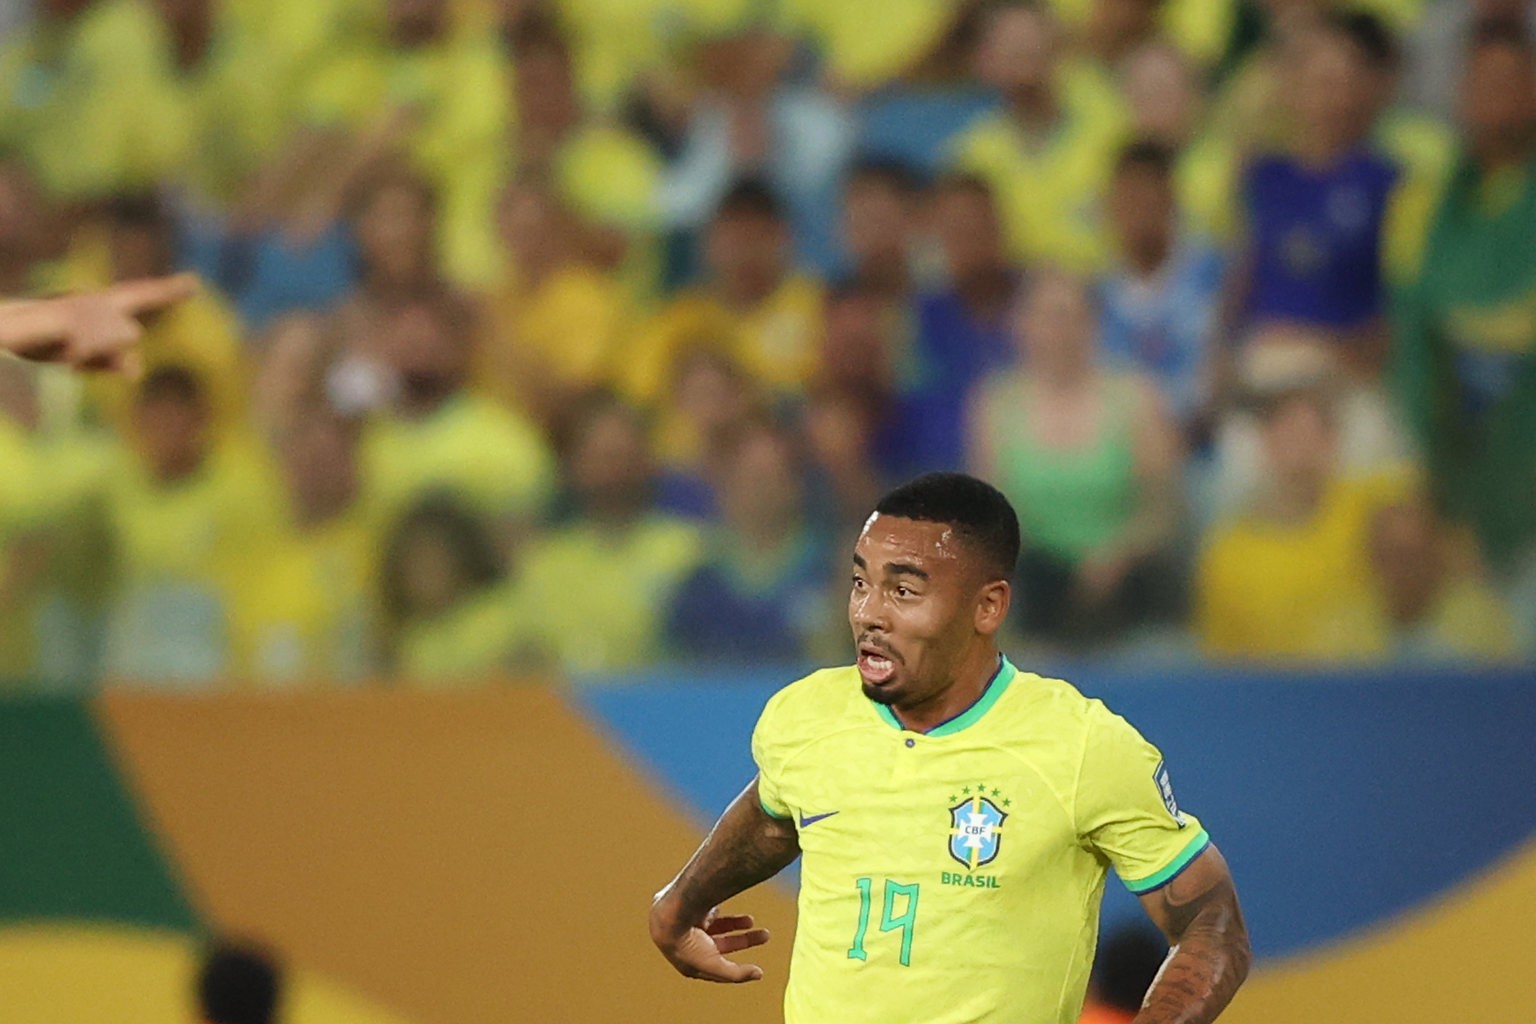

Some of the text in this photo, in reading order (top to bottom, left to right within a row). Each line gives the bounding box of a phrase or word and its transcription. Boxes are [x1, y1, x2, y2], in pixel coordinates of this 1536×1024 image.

[964, 825, 986, 835] CBF
[941, 871, 1001, 889] BRASIL
[847, 877, 920, 967] 19
